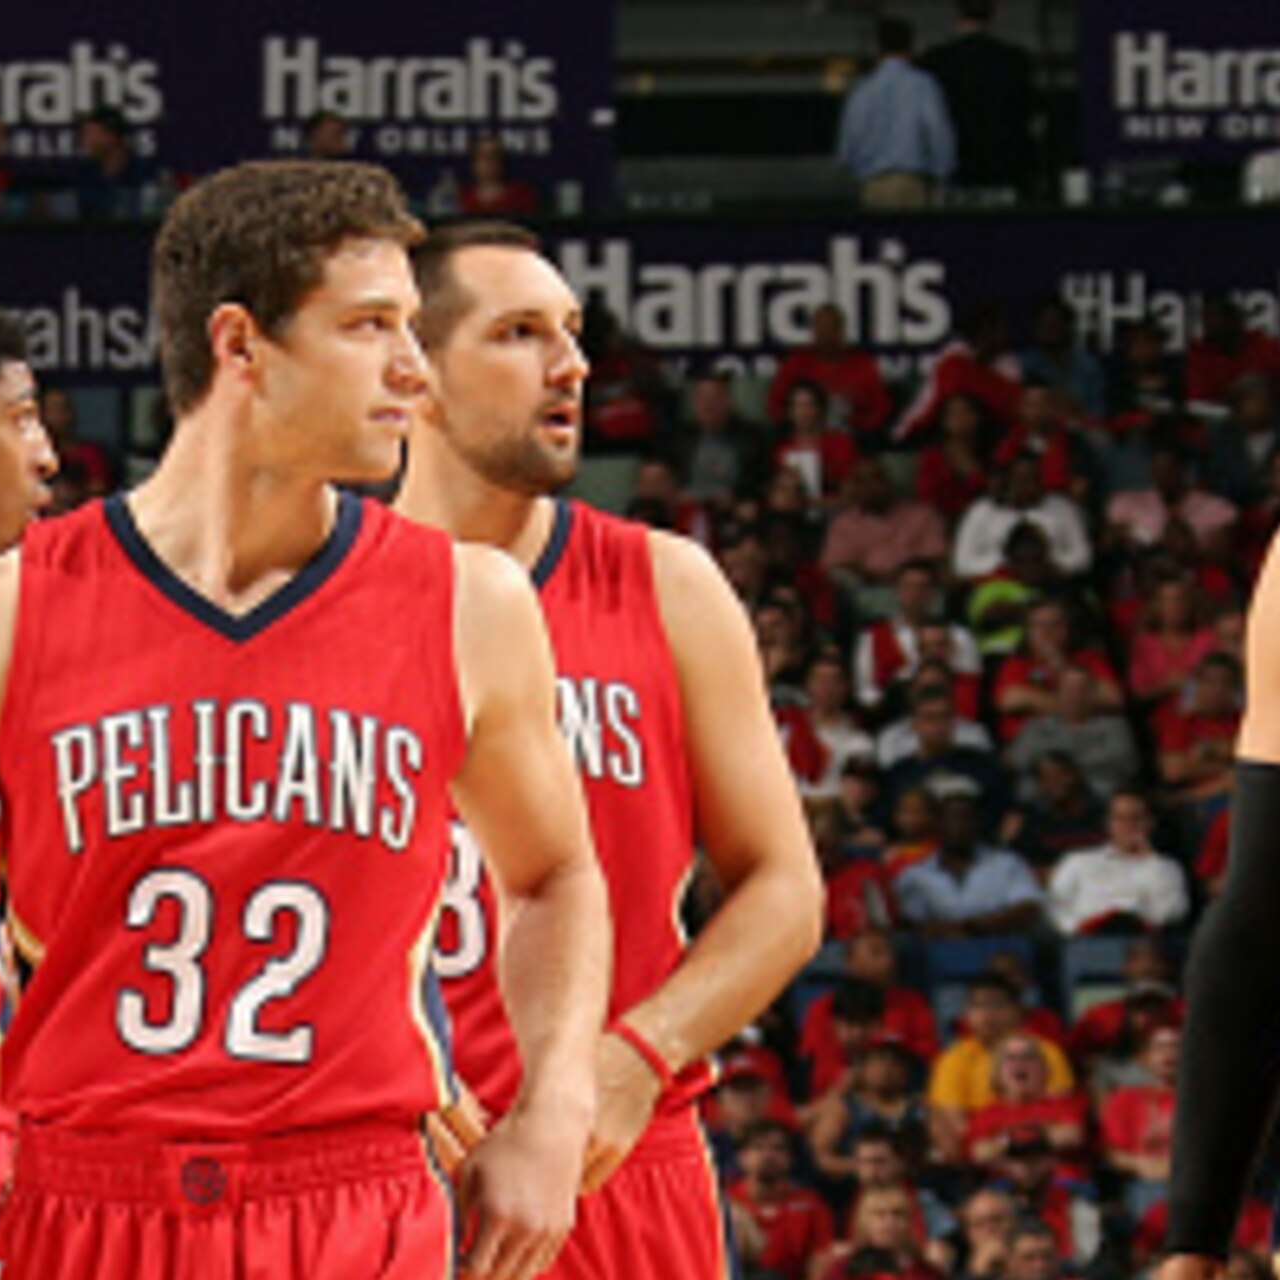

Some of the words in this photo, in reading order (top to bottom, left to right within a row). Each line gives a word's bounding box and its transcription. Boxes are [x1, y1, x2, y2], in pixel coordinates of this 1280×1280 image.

[263, 36, 558, 121] Harrah's
[1124, 114, 1205, 139] NEW
[562, 238, 952, 346] Harrah's
[51, 699, 422, 853] PELICANS
[117, 867, 329, 1064] 32
